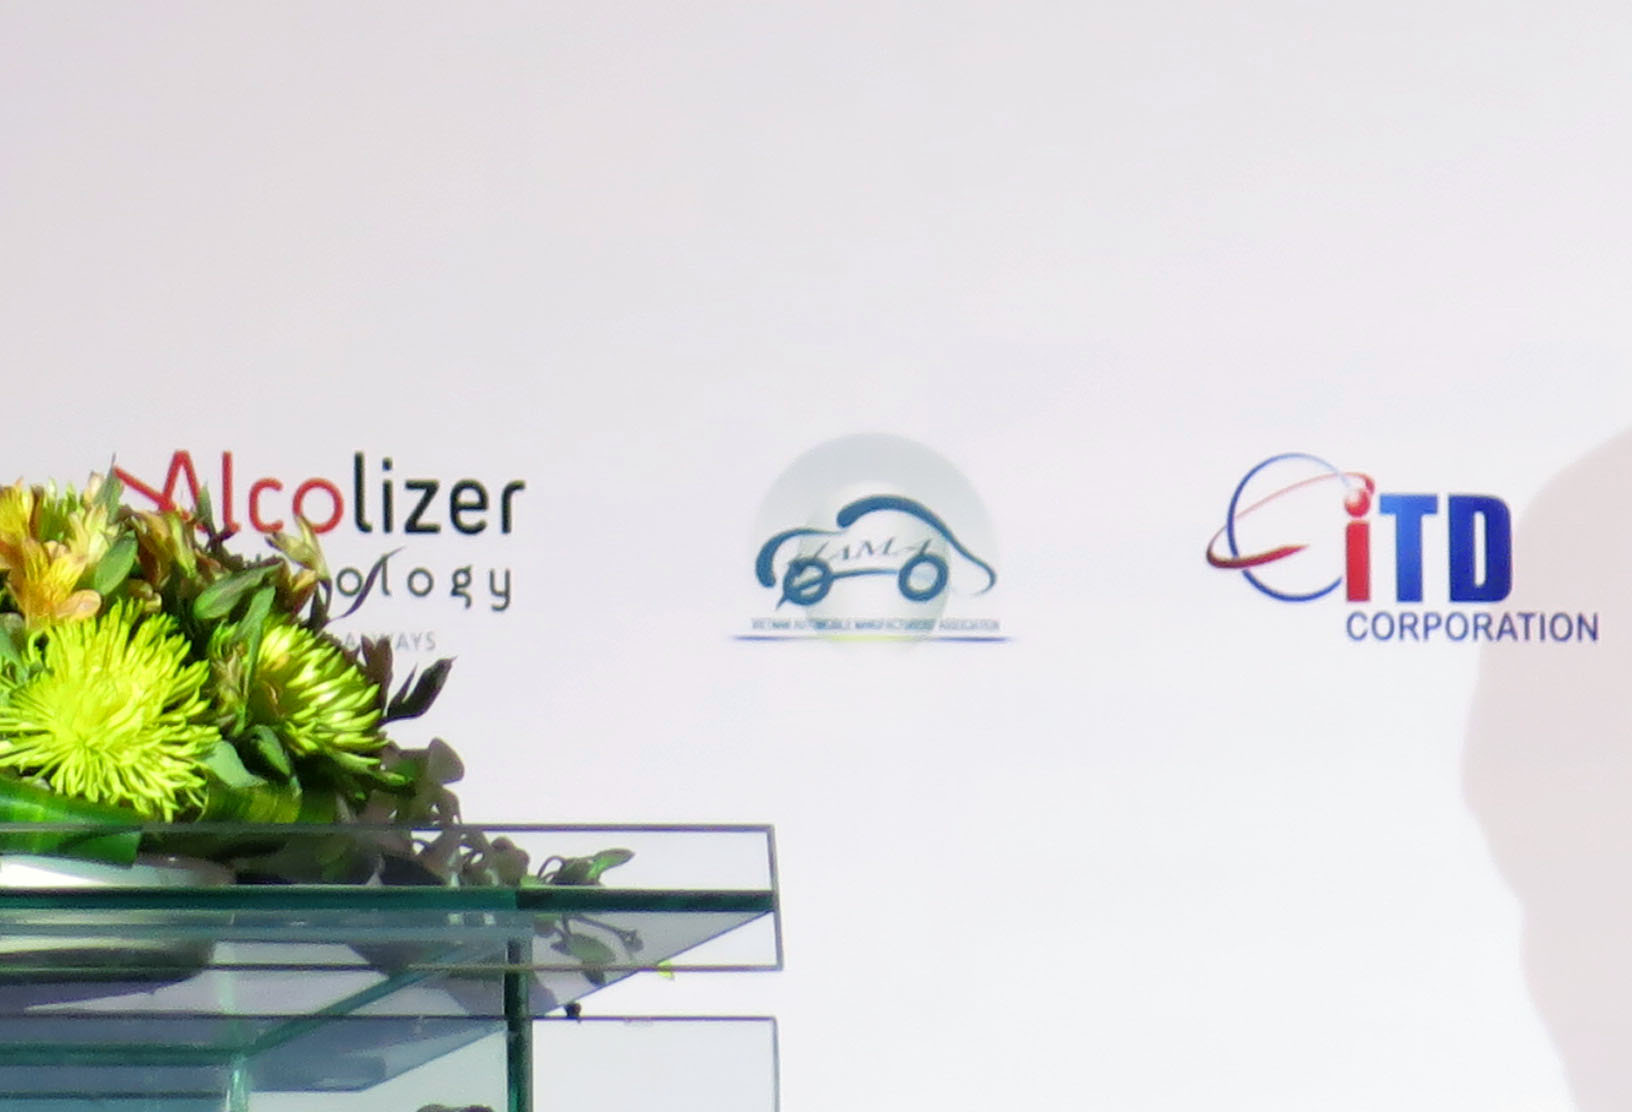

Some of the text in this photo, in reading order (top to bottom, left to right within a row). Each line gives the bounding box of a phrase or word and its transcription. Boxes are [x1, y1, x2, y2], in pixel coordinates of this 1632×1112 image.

[114, 449, 527, 536] Alcolizer
[335, 553, 512, 612] ology
[1345, 611, 1600, 643] CORPORATION
